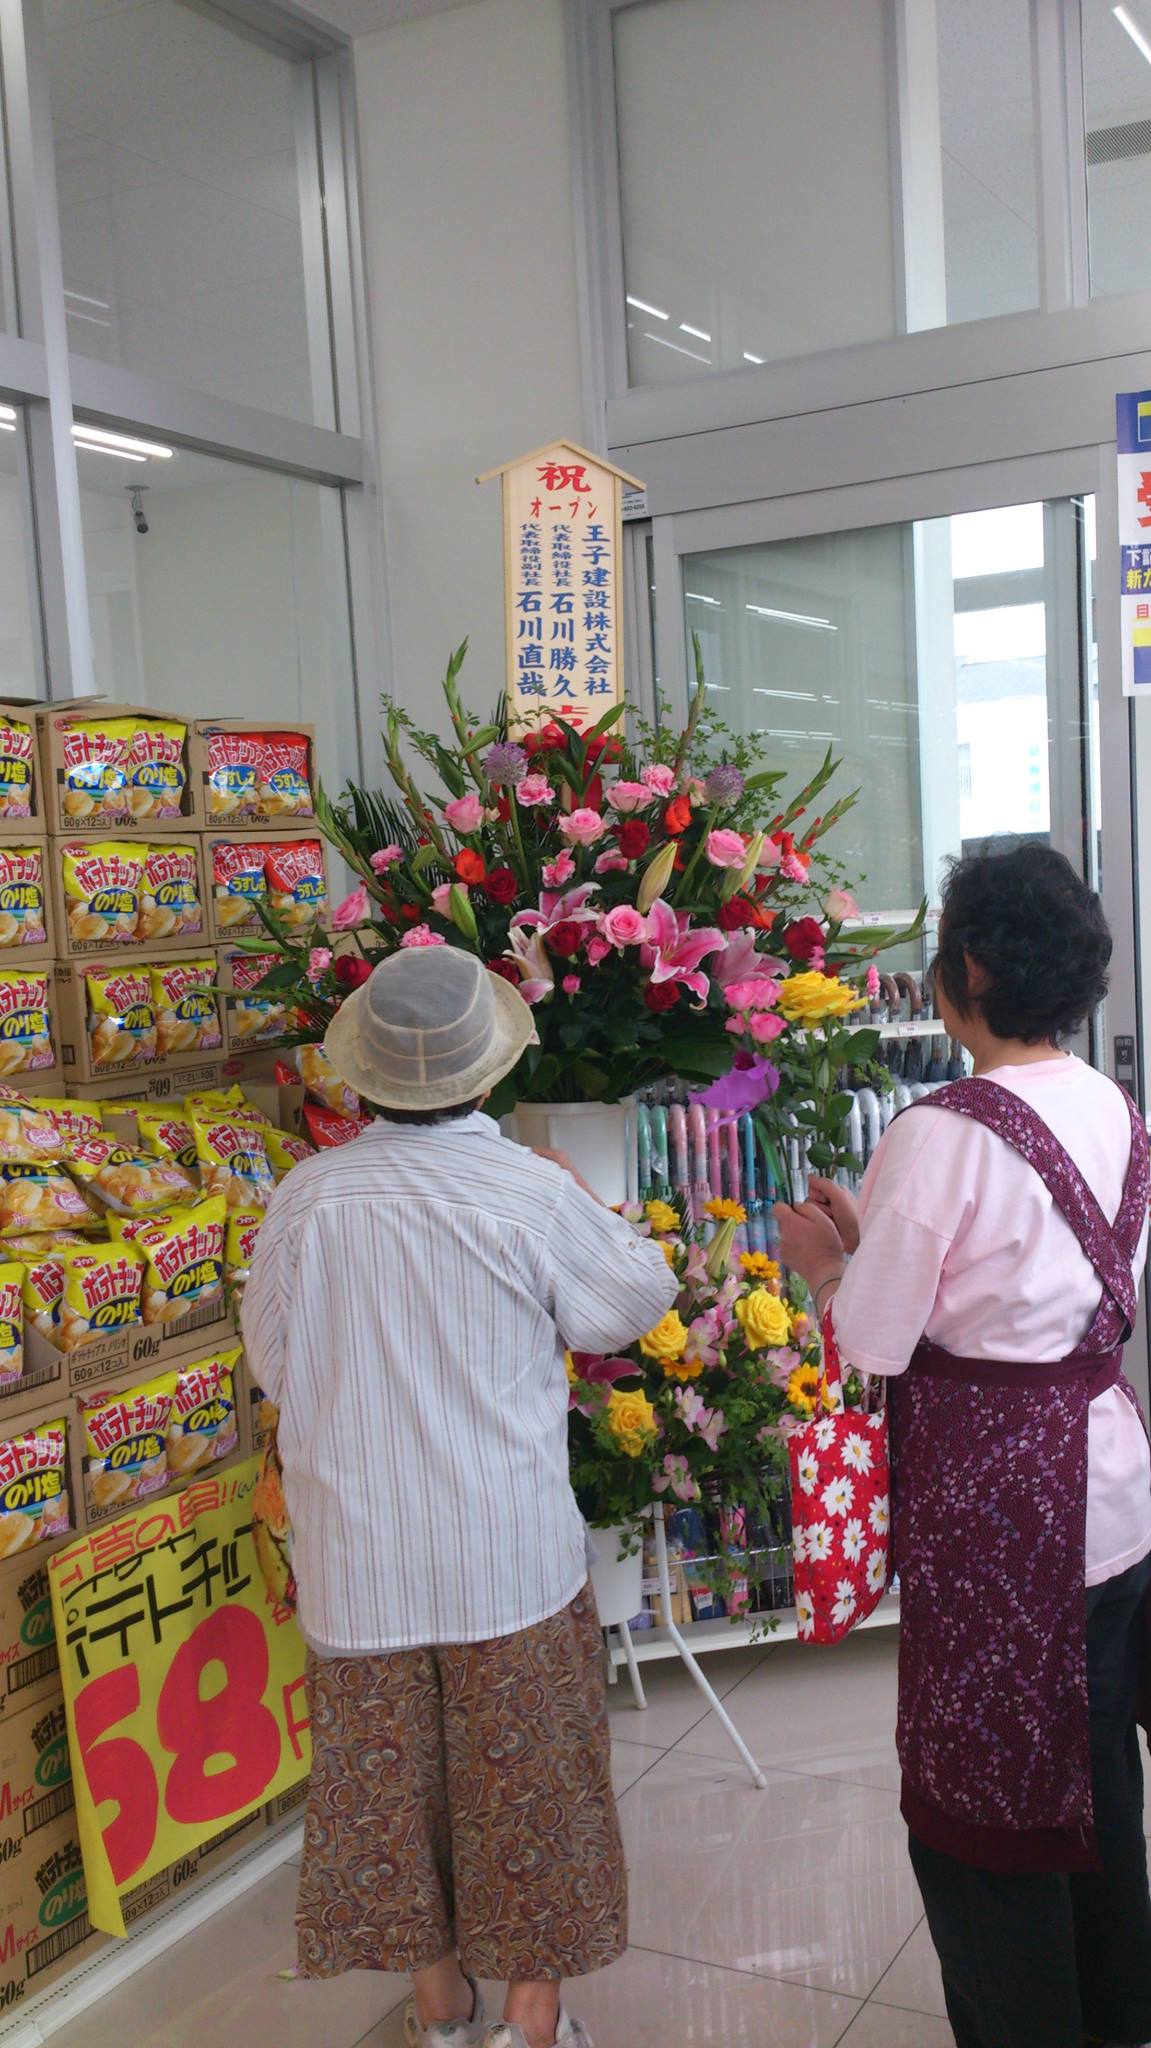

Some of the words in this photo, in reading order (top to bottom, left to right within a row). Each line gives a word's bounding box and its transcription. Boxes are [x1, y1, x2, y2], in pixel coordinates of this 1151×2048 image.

[536, 462, 592, 493] 祝
[530, 496, 599, 520] オープン
[581, 525, 613, 696] 王子建設株式会社
[173, 1261, 219, 1297] のり塩
[133, 1335, 161, 1361] 60g
[111, 1438, 161, 1468] のり塩
[5, 1470, 61, 1510] のり塩
[172, 1857, 199, 1888] 60g
